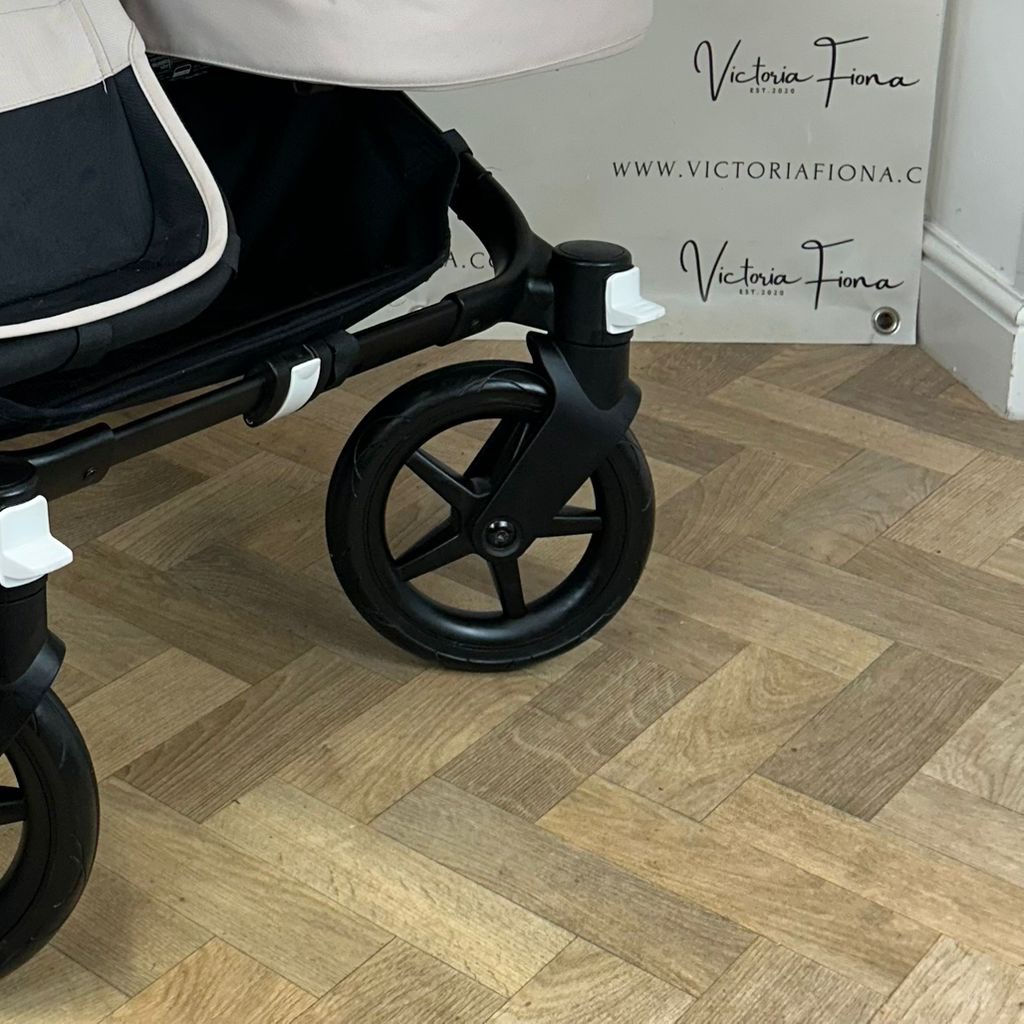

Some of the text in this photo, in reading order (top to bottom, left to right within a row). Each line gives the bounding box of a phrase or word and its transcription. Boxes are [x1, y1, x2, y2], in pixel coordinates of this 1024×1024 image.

[693, 36, 921, 108] Victoria Fiona
[613, 161, 922, 184] WWW.VICTORIAFIONA.C
[680, 238, 904, 310] Victoria Fiona
